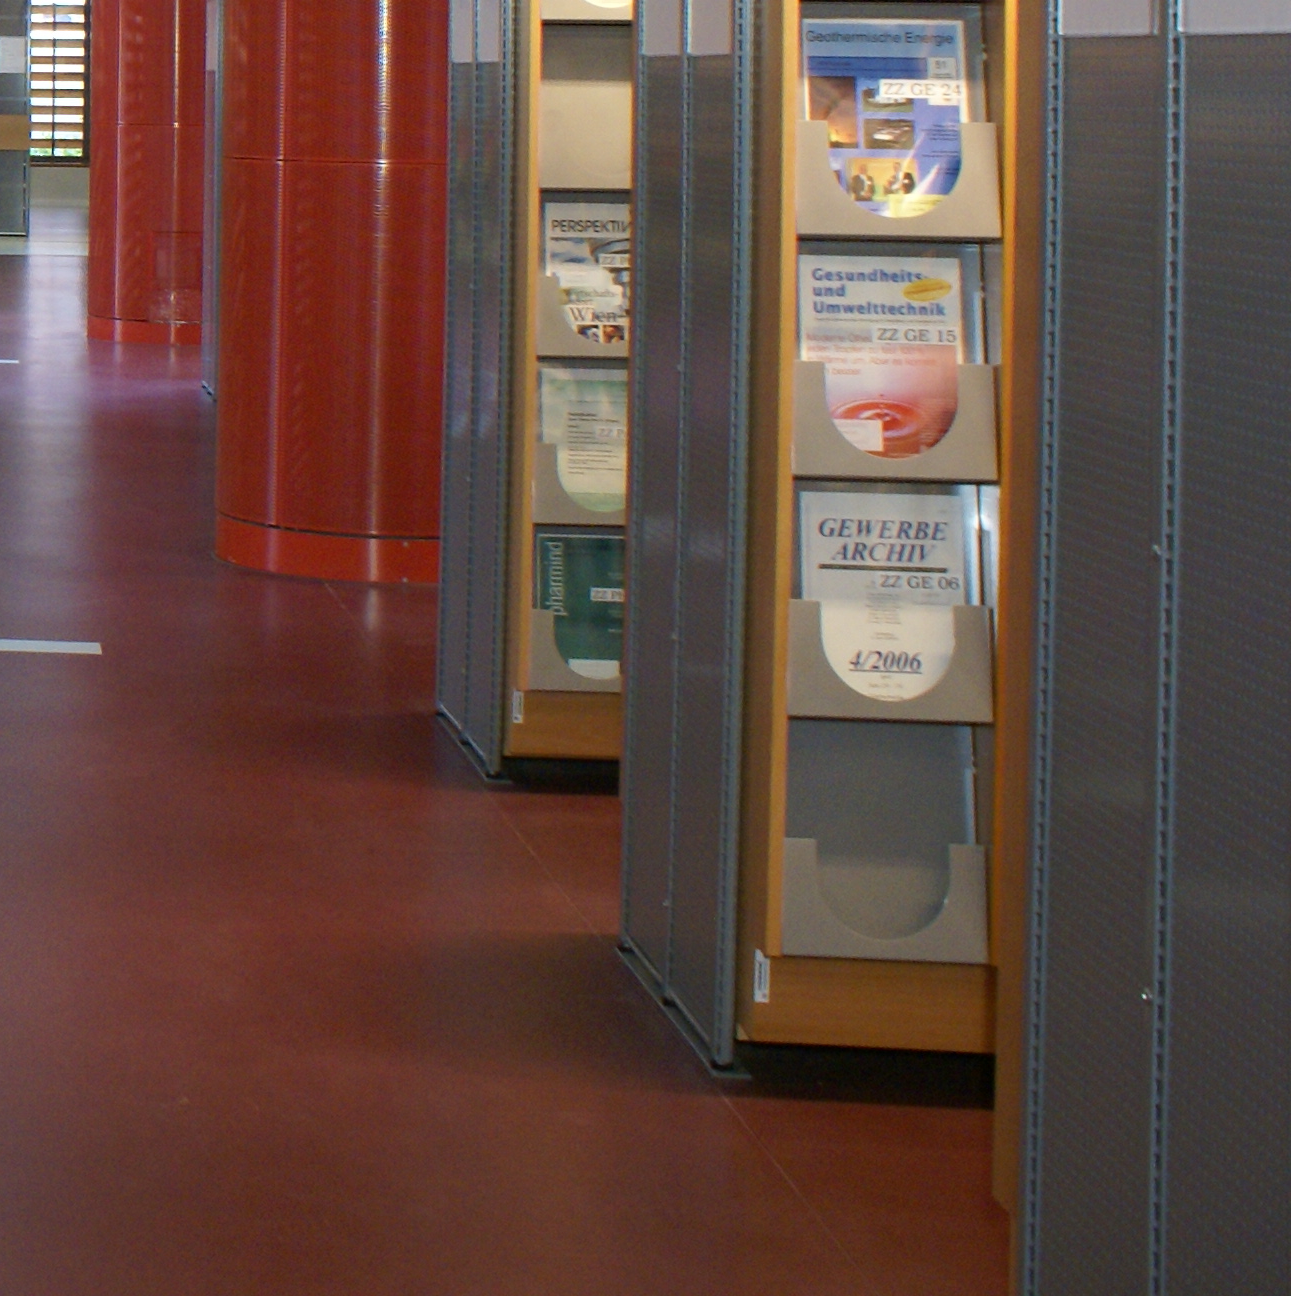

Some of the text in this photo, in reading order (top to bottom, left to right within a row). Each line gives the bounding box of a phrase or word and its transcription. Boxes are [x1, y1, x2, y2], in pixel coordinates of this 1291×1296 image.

[806, 30, 954, 47] Geothermische Energie
[883, 83, 961, 96] ZZ GE 24
[812, 285, 846, 298] und
[812, 301, 946, 316] Umwelttechnik
[877, 328, 957, 343] ZZ GE 15
[819, 518, 948, 542] GEWERBE
[832, 542, 932, 563] ARCHIV
[880, 574, 960, 591] ZZ GE 06
[849, 649, 923, 671] 4/2006
